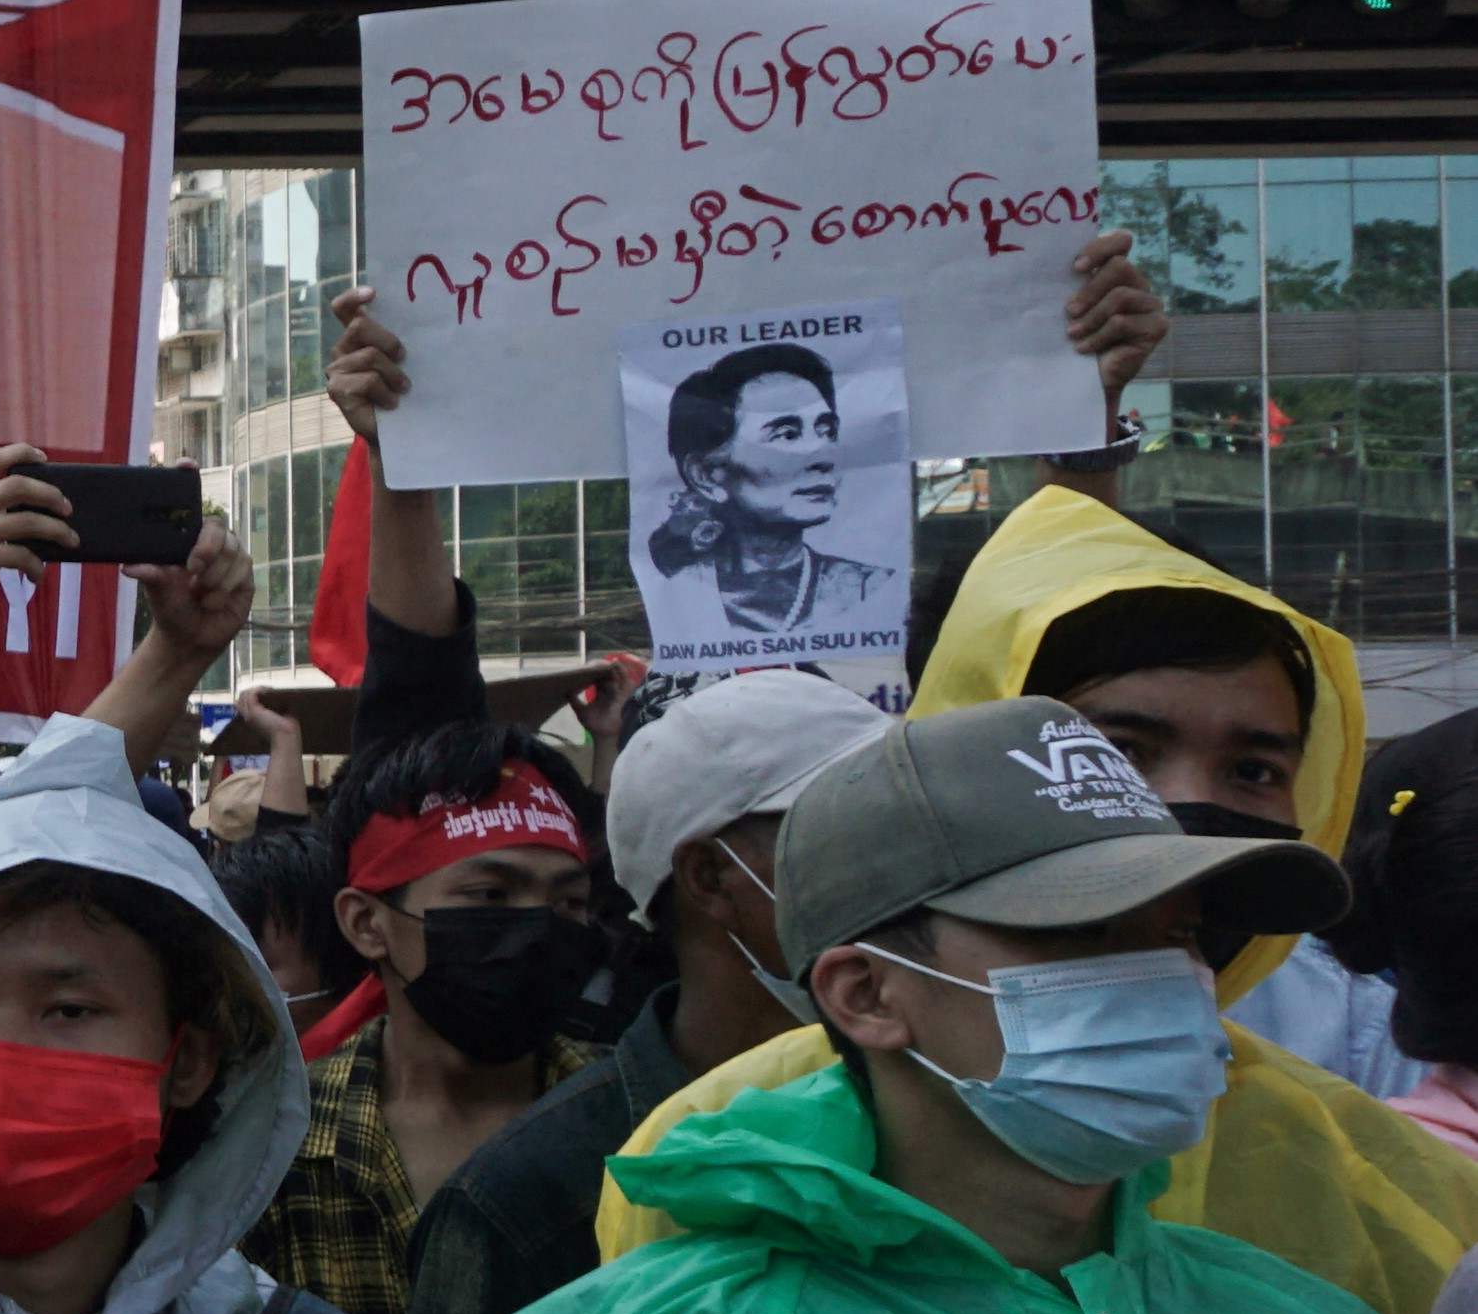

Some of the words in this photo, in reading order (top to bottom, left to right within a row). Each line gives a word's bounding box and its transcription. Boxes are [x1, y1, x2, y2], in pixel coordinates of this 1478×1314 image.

[662, 324, 730, 349] OUR
[740, 314, 864, 344] LEADER
[658, 643, 697, 661] DAW
[698, 639, 759, 659] AUNG
[761, 635, 808, 655] SAN
[810, 631, 858, 652] SUU
[860, 629, 901, 649] KYI
